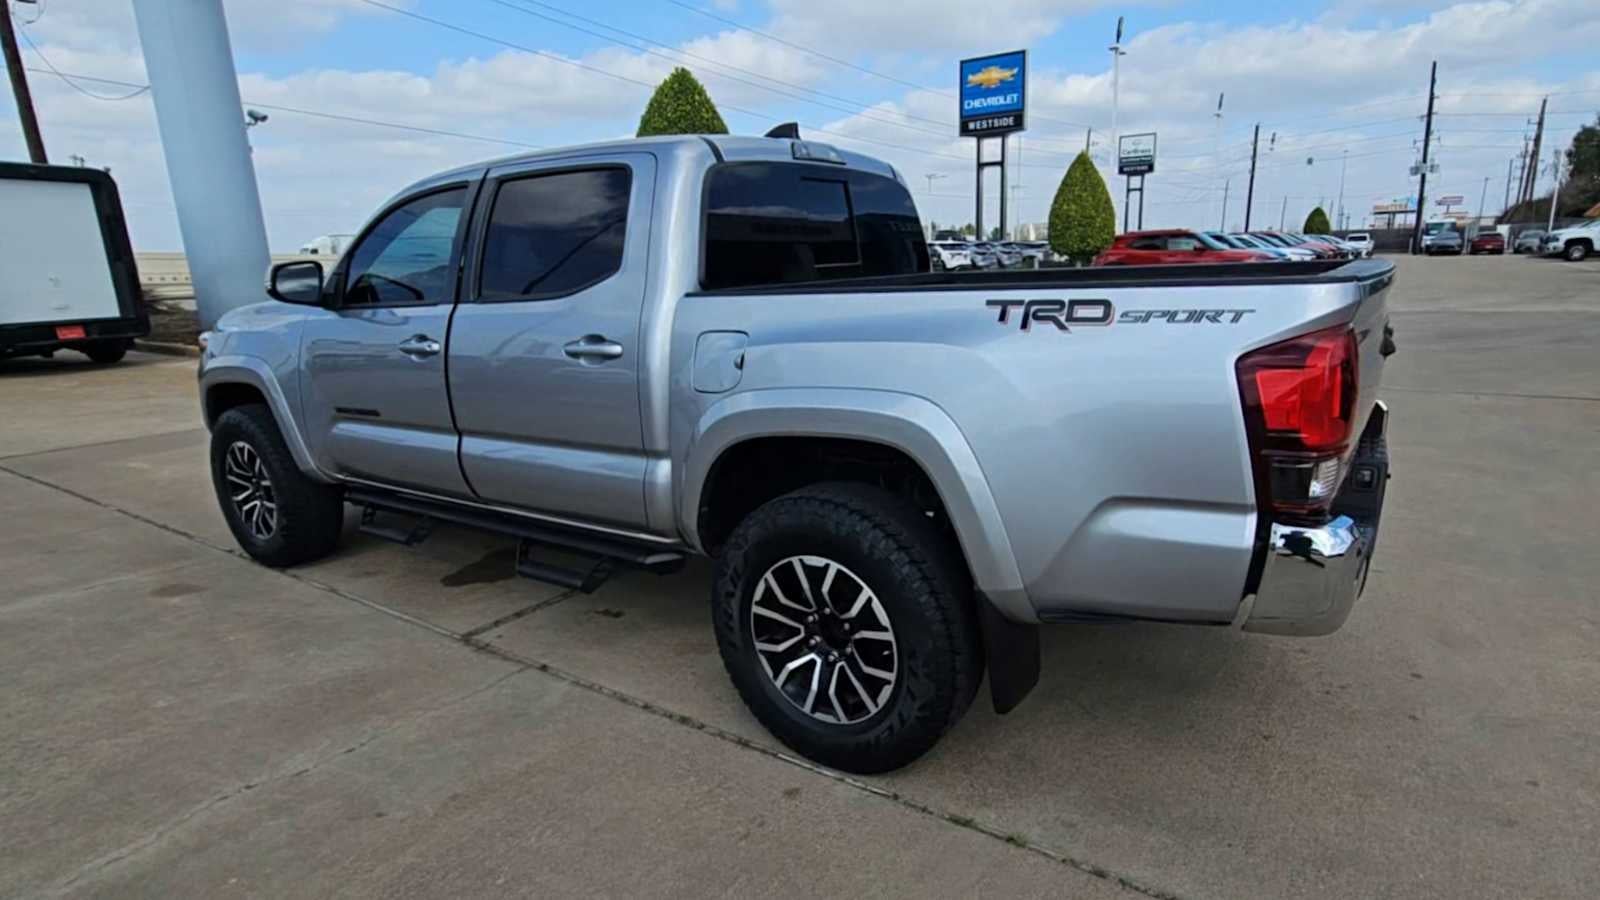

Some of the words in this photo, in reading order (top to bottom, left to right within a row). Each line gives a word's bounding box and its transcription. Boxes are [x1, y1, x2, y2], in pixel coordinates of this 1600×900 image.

[964, 93, 1019, 110] CHEVROLET
[968, 116, 1015, 131] WESTSIDE
[985, 299, 1115, 333] TRD
[1117, 309, 1256, 324] SPORT
